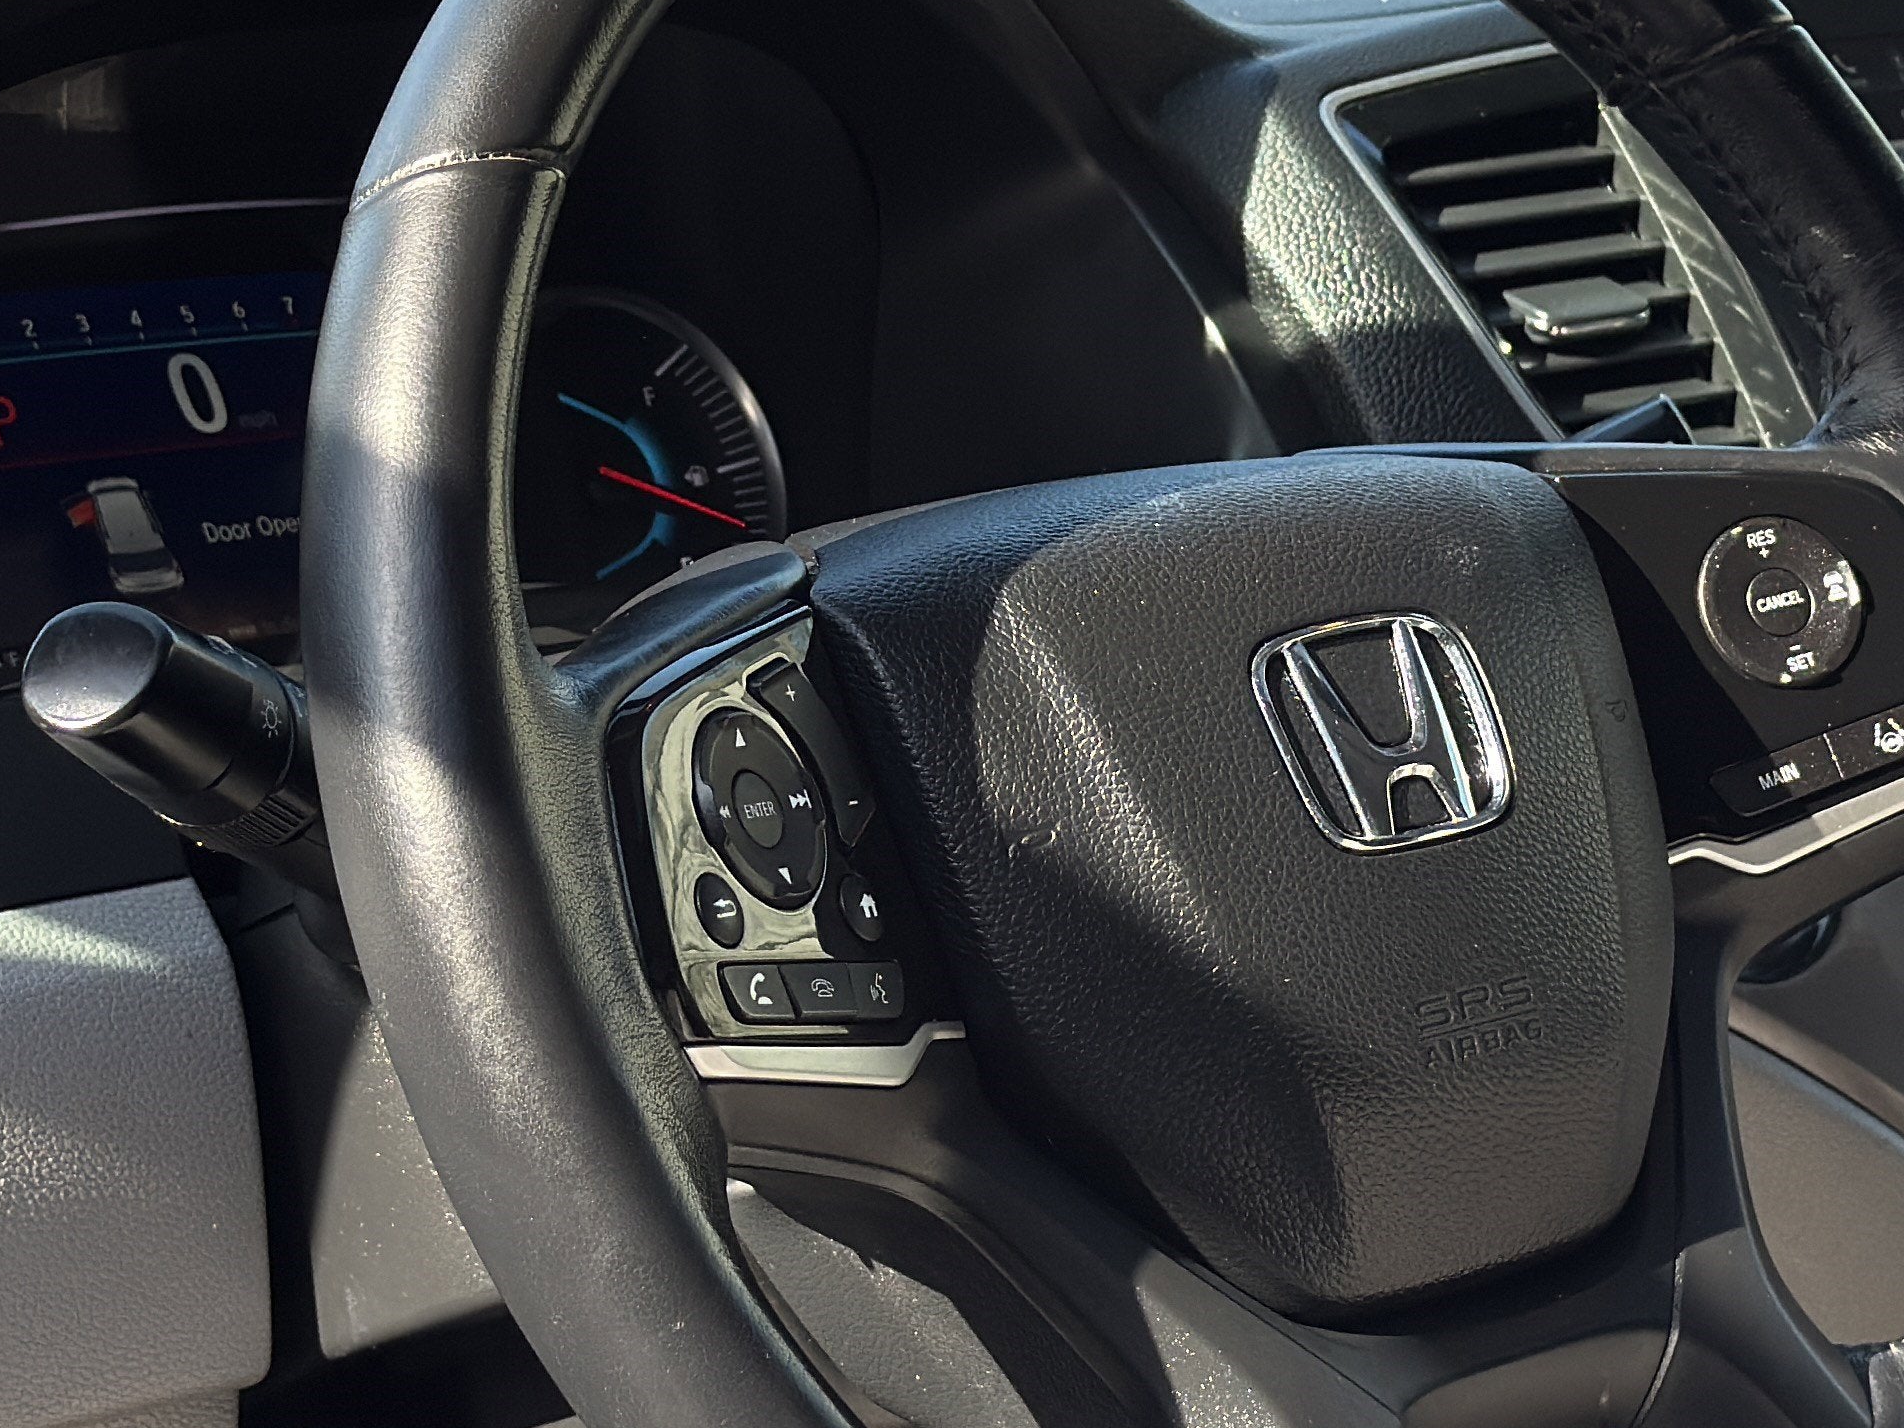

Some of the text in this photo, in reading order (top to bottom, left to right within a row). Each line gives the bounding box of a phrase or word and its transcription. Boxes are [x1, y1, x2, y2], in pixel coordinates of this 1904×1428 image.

[20, 318, 37, 339] 2
[74, 312, 91, 334] 3
[130, 308, 145, 328] 4
[179, 303, 196, 325] 5
[231, 299, 247, 320] 6
[280, 294, 295, 317] 7
[166, 352, 229, 434] 0
[201, 515, 300, 546] Door Ope
[1746, 528, 1777, 549] RES
[1755, 588, 1805, 614] CANCEL
[1786, 650, 1817, 673] SET
[1757, 761, 1801, 792] MAIN
[745, 799, 777, 820] ENTER
[1414, 974, 1536, 1027] SRS
